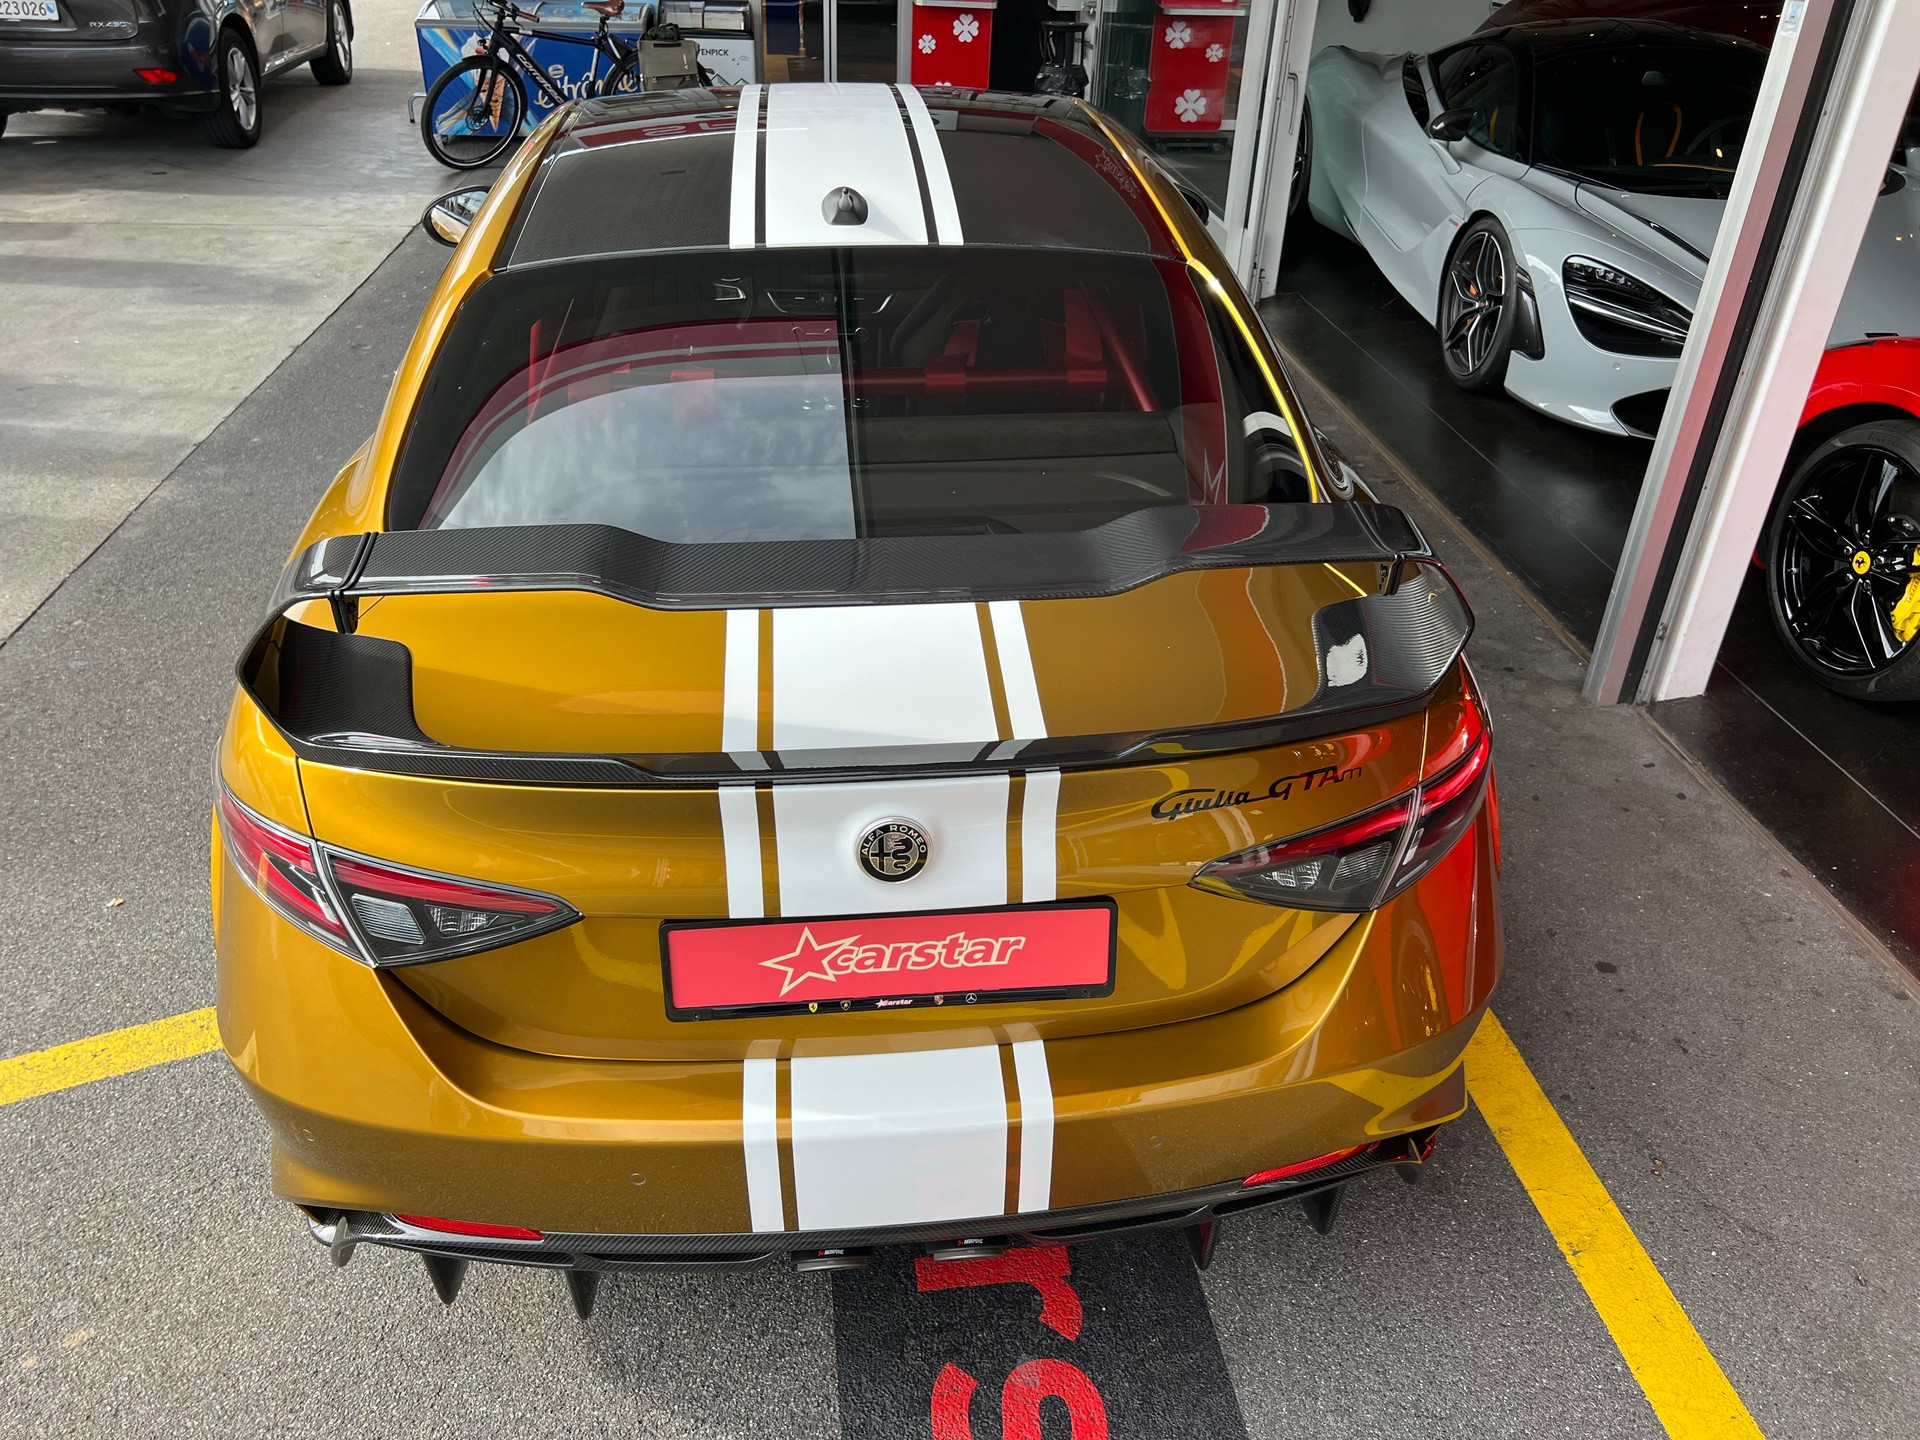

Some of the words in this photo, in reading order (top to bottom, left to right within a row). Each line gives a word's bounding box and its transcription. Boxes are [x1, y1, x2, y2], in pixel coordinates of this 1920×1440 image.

[699, 48, 729, 57] ENPICK
[1151, 788, 1251, 820] Giulia
[861, 828, 884, 856] ALFA
[889, 824, 927, 853] ROMEO
[828, 931, 1026, 975] carstar
